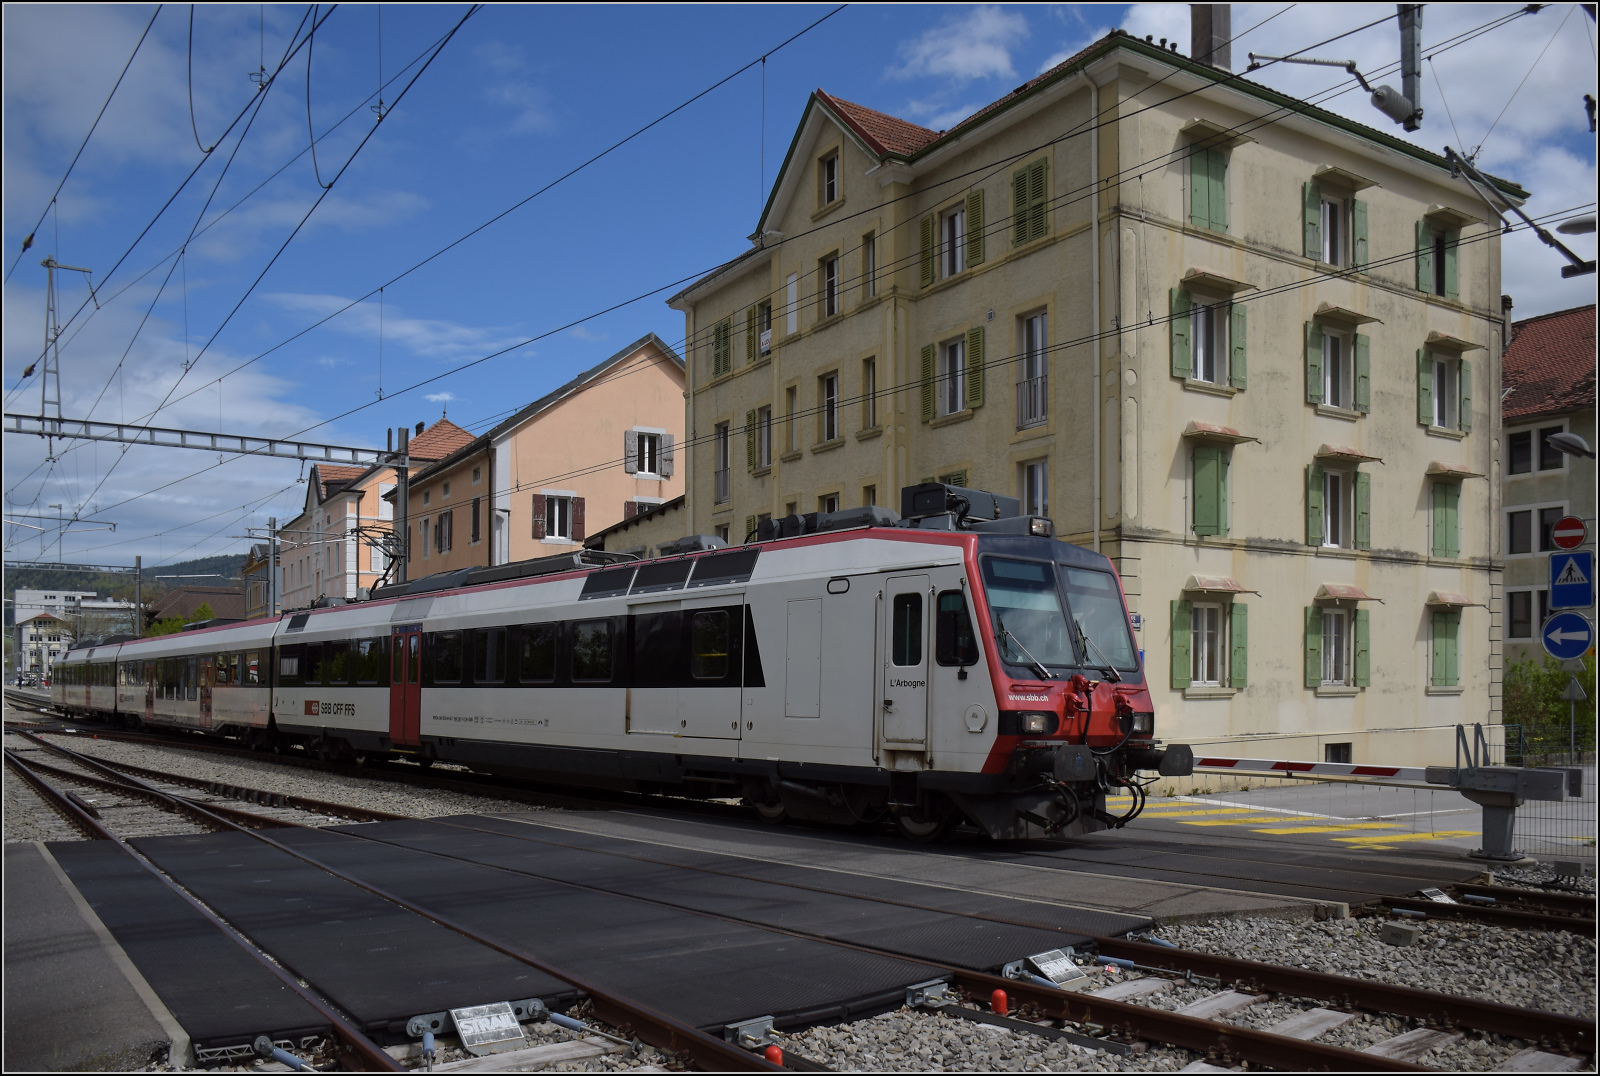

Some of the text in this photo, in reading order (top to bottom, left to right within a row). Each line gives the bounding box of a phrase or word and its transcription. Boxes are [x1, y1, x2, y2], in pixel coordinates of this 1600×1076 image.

[890, 678, 926, 689] L'Arbogne
[1008, 694, 1049, 702] www.sbb.ch
[320, 702, 356, 716] SBB CFF FFS
[459, 1014, 518, 1035] STRAIL
